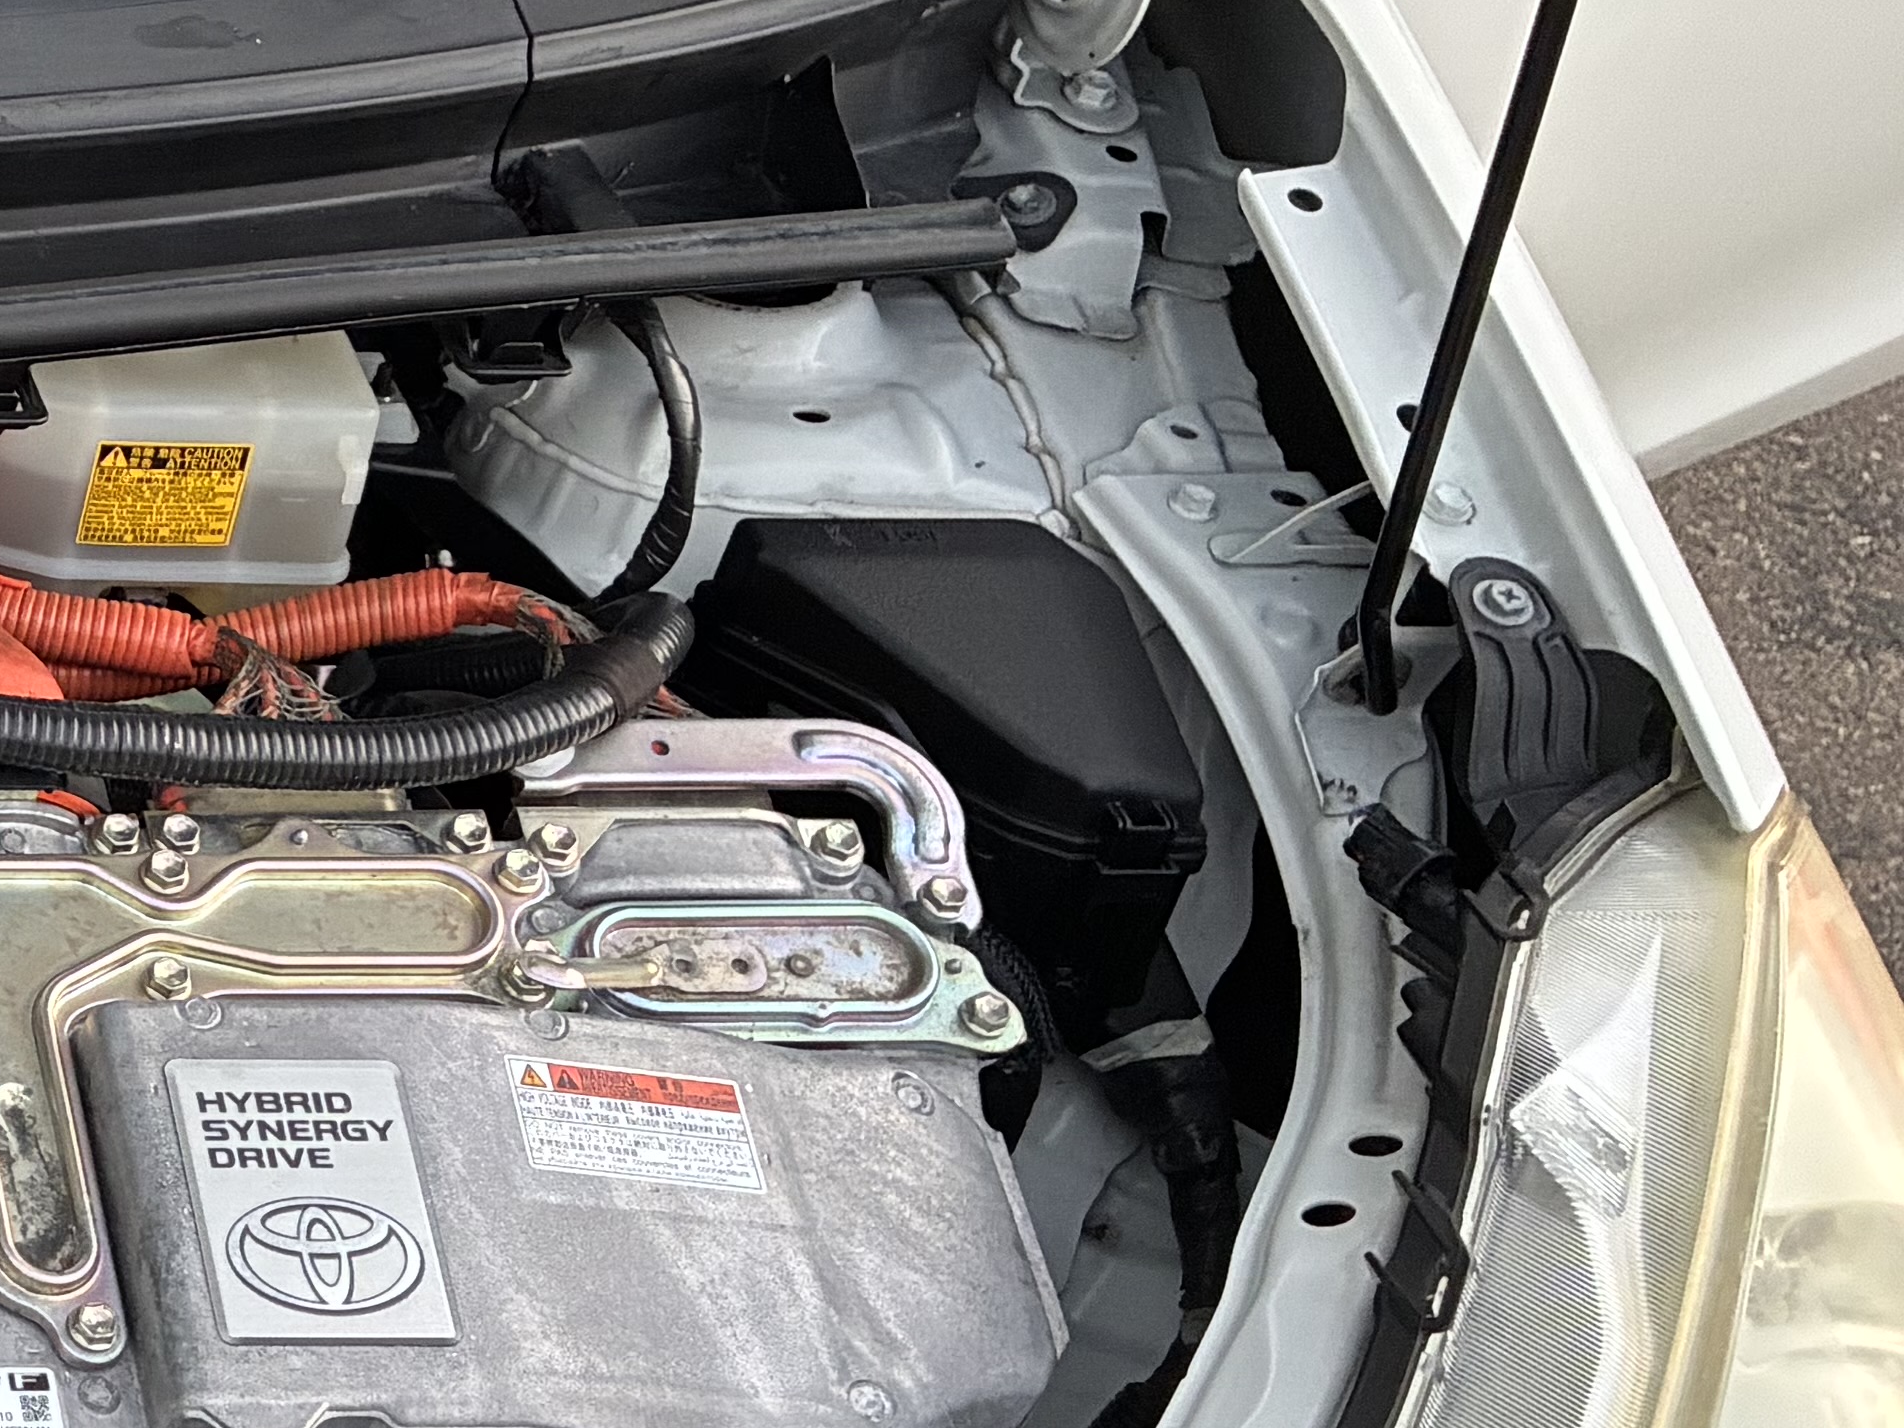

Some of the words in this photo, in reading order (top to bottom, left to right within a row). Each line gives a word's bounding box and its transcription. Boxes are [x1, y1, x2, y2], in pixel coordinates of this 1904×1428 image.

[184, 447, 243, 459] CAUTION
[165, 458, 240, 470] ATTENTION
[579, 1069, 636, 1087] WARNING
[195, 1091, 352, 1113] HYBRID
[201, 1119, 394, 1141] SYNERGY
[207, 1147, 334, 1169] DRIVE
